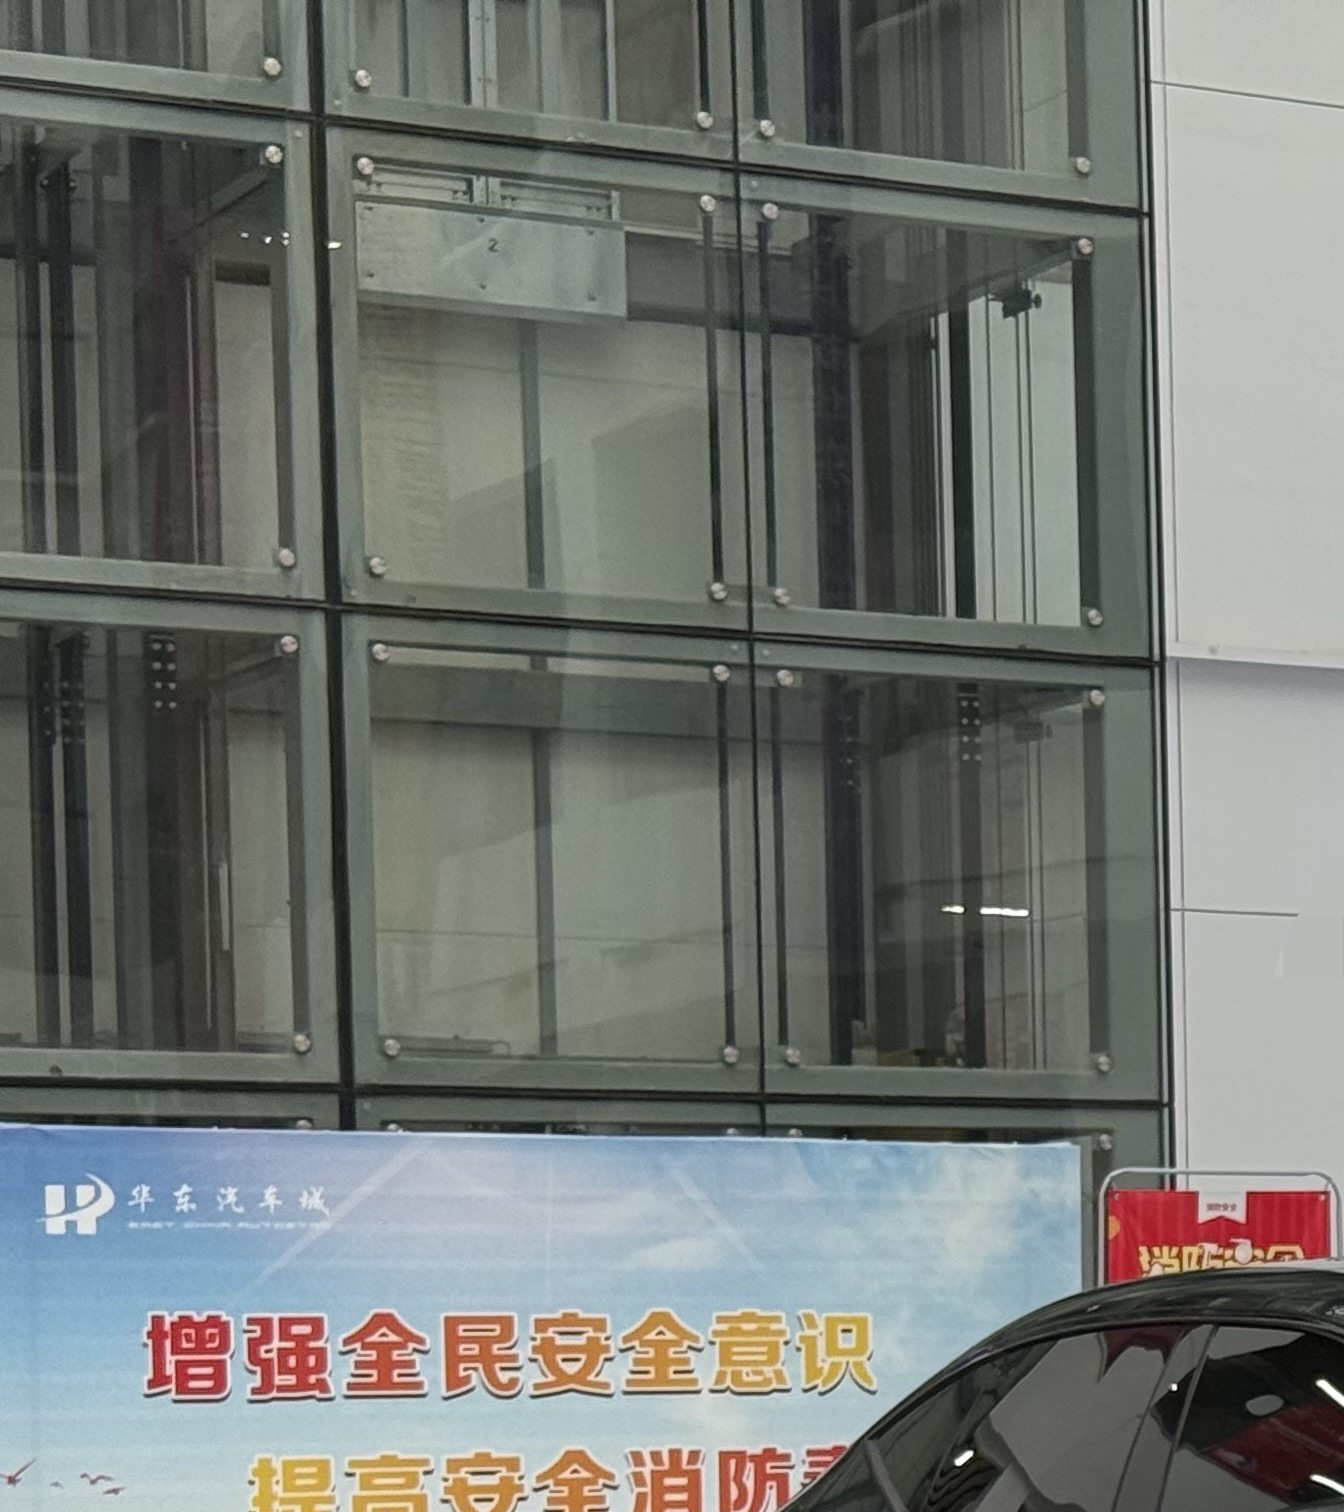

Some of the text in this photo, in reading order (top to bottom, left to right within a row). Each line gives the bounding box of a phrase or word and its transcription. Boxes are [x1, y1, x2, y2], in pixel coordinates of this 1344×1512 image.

[487, 238, 499, 253] 2
[127, 1183, 331, 1216] 华东汽车城
[144, 1308, 878, 1400] 增强全民安全意识
